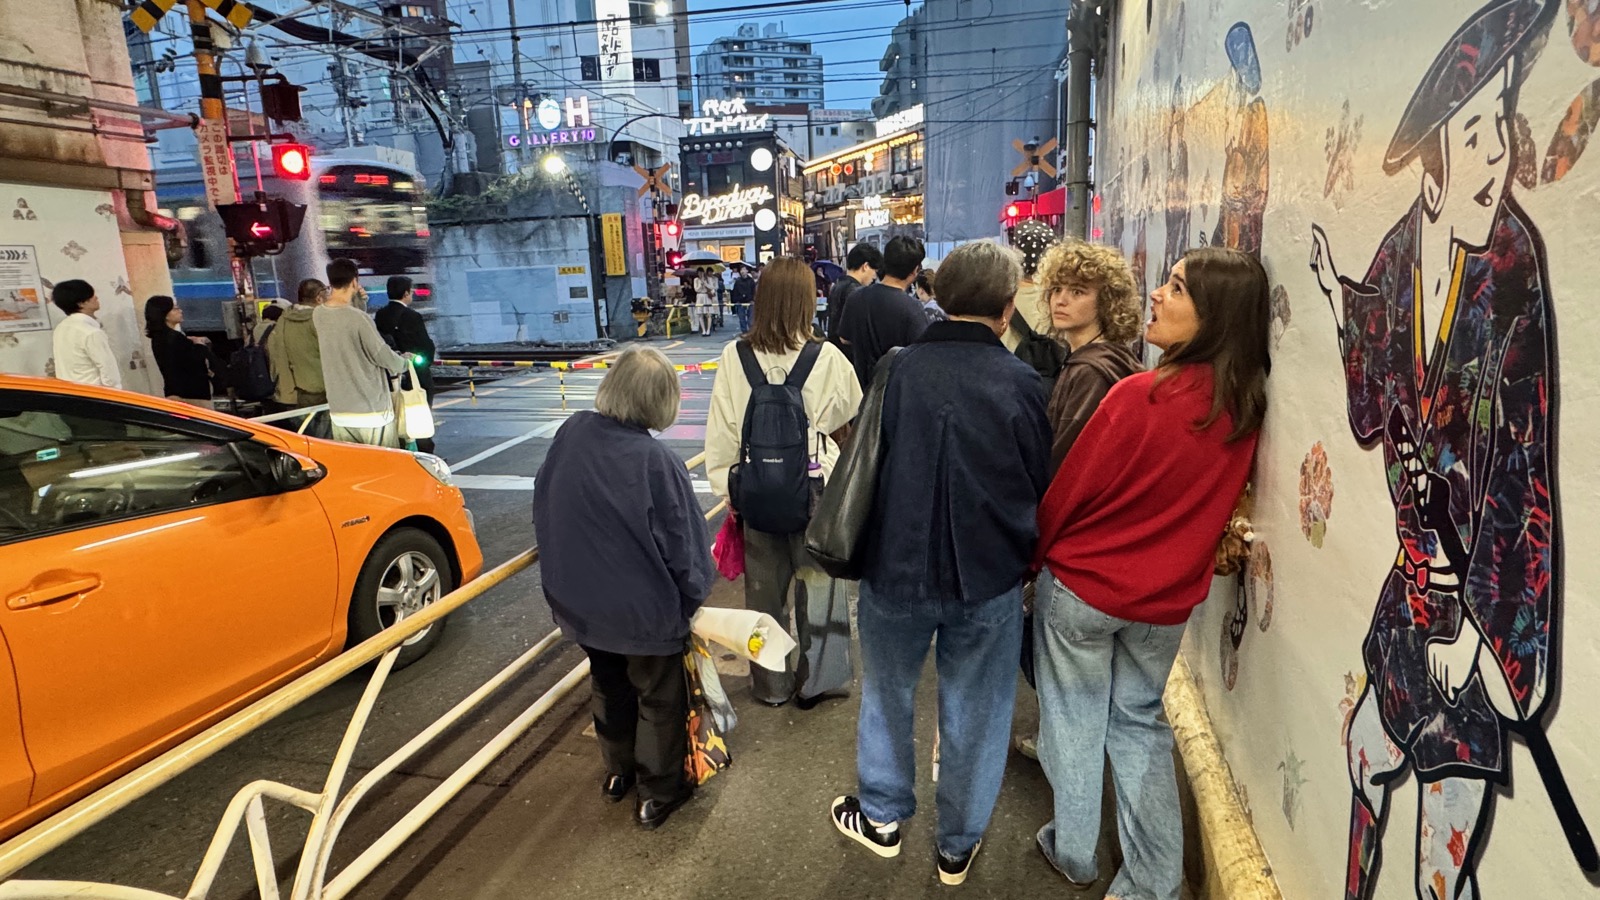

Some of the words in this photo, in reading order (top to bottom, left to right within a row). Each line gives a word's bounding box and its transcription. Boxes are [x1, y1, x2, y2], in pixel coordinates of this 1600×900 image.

[703, 97, 747, 116] 代々木
[680, 183, 775, 219] Broadway
[701, 202, 754, 225] Diner
